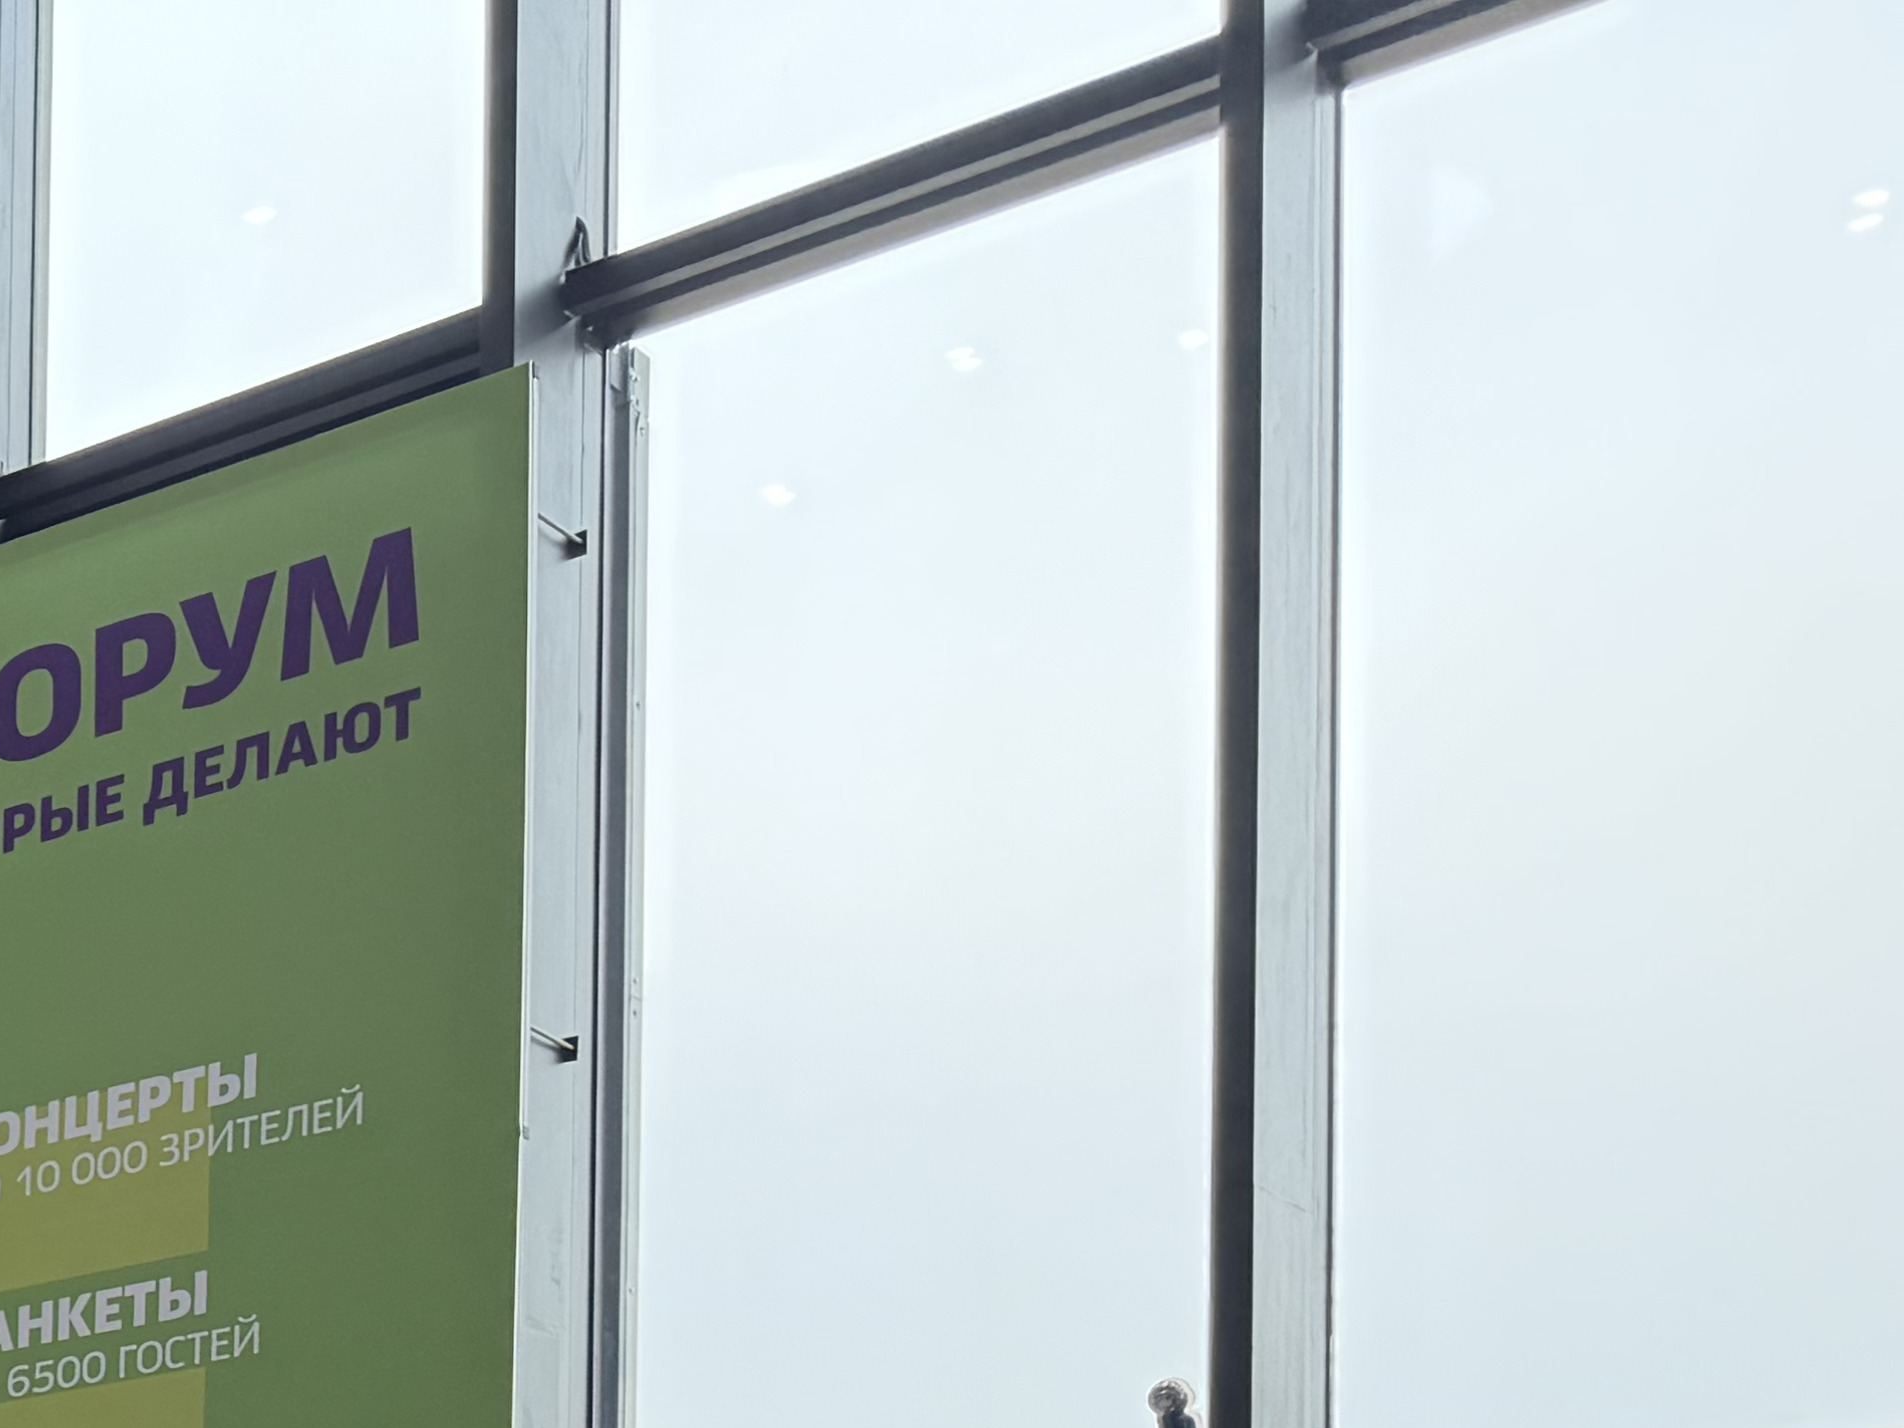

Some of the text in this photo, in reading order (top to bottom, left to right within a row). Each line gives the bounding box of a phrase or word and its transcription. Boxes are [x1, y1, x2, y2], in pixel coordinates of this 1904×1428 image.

[141, 685, 423, 828] ДЕЛАЮТ
[16, 1158, 61, 1202] 10
[71, 1138, 149, 1190] 000
[157, 1084, 367, 1173] ЗРИТЕЛЕЙ
[5, 1349, 109, 1402] 6500
[116, 1315, 263, 1383] ГОСТЕЙ
